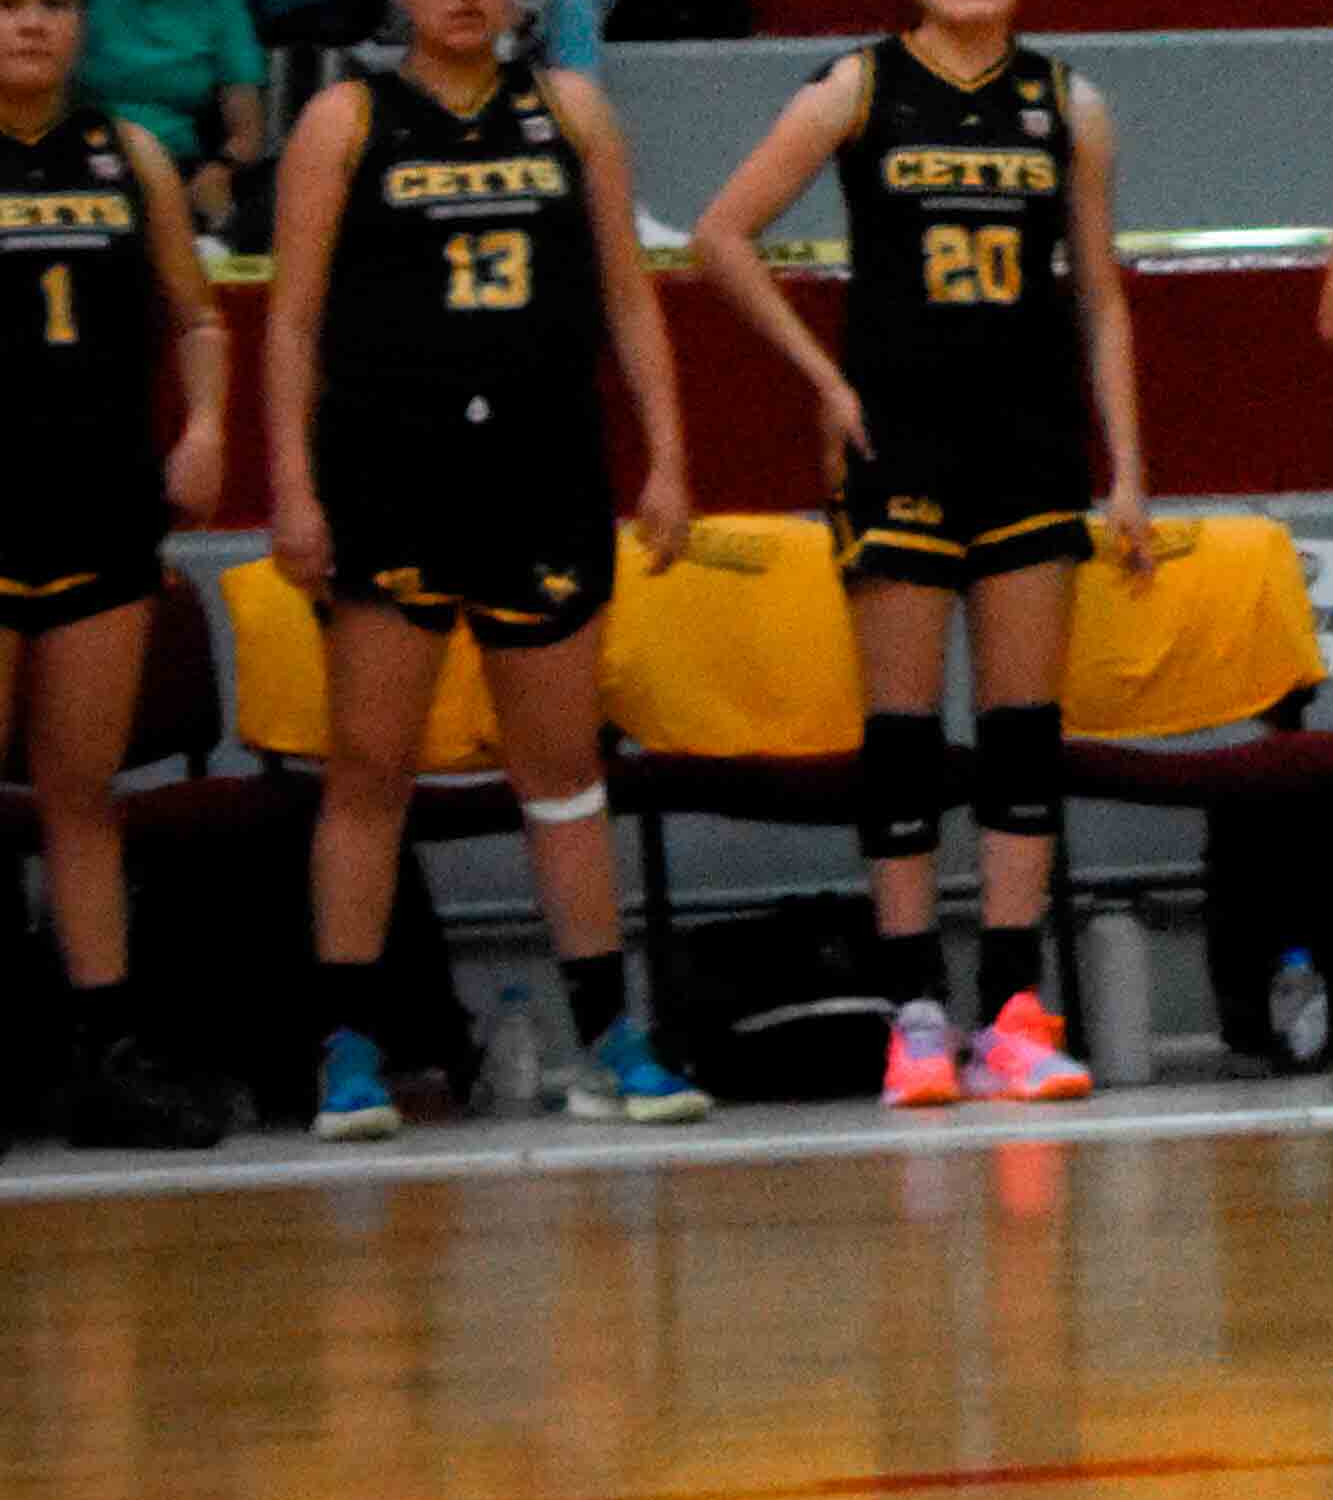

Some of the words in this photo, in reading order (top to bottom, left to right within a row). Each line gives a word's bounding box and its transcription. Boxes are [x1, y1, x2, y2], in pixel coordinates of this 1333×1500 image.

[880, 147, 1061, 195] CETYS
[40, 261, 80, 345] 1
[443, 228, 536, 312] 13
[919, 222, 1025, 307] 20
